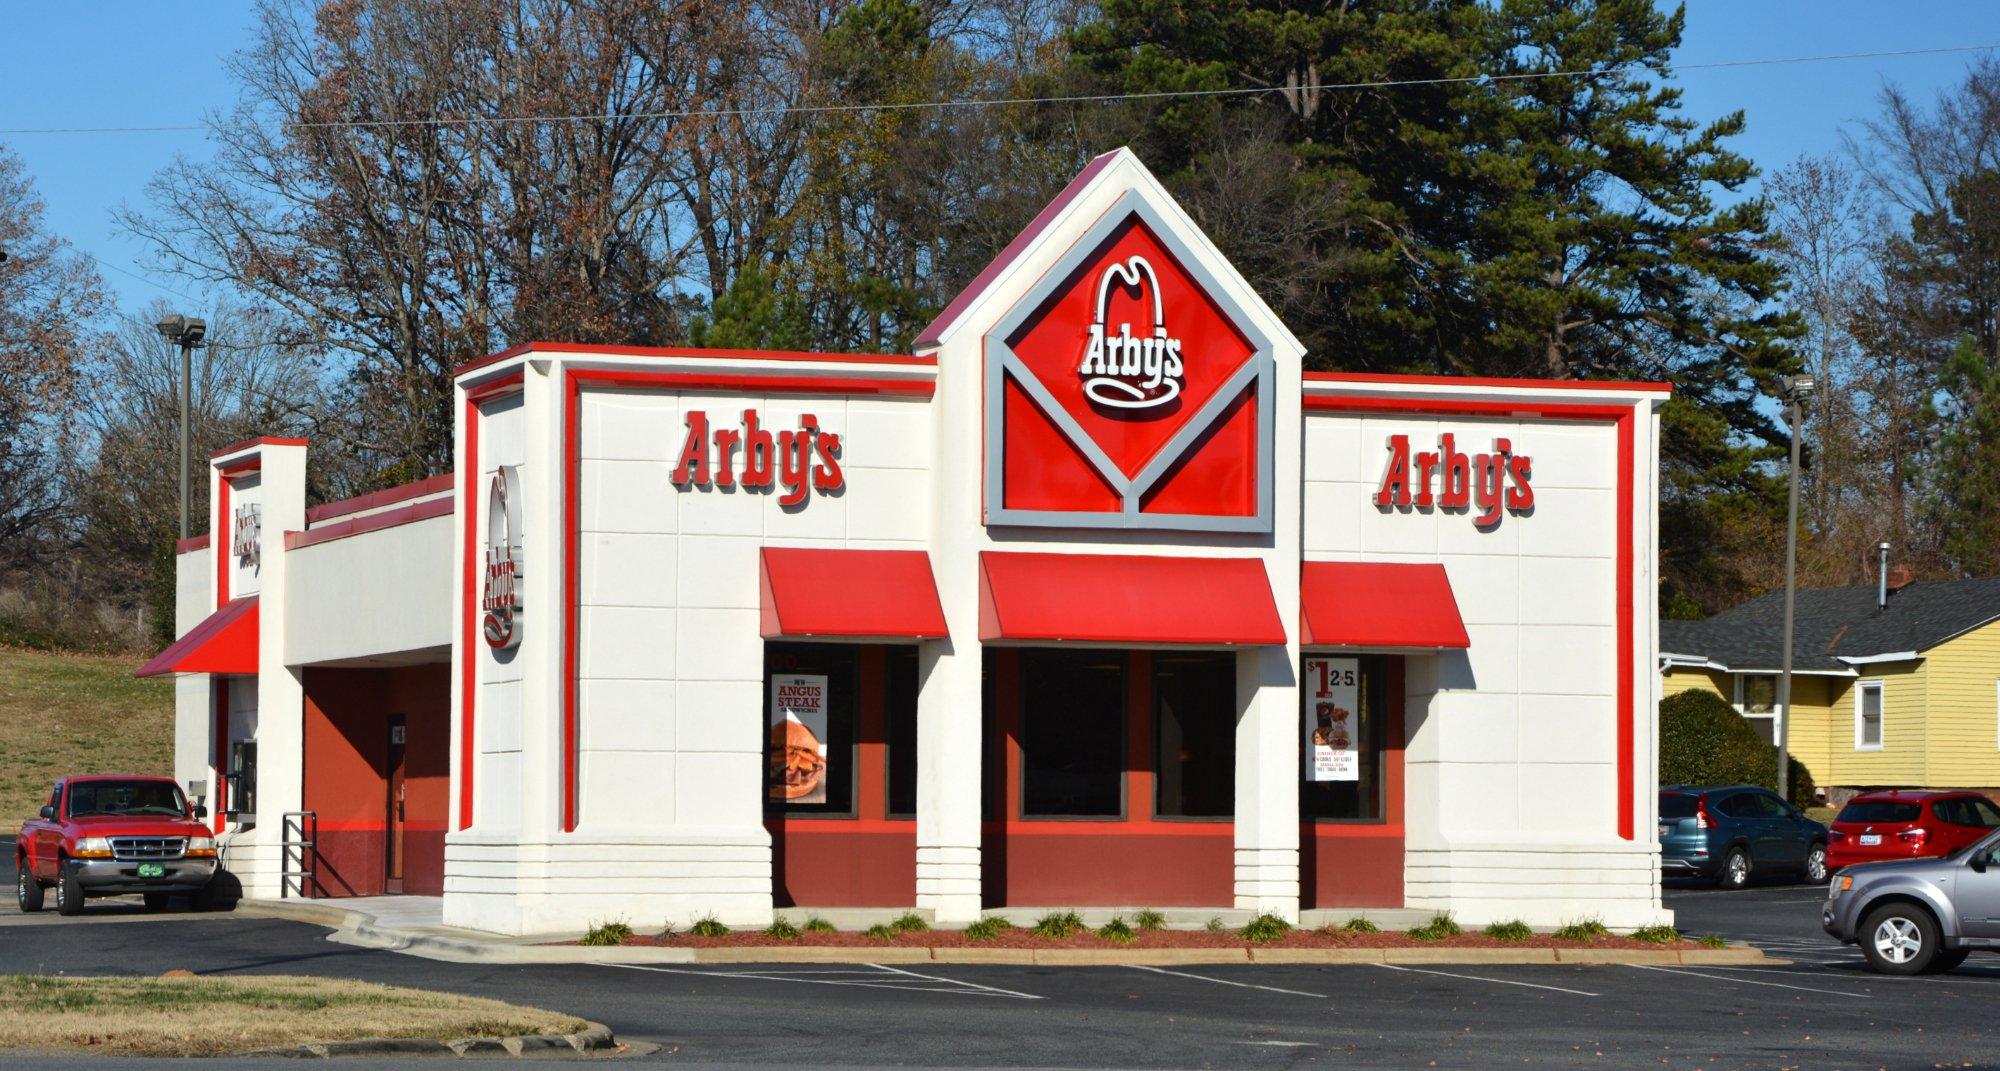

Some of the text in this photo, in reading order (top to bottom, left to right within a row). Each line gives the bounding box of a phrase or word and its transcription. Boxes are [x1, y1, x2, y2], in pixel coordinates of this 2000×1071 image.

[1079, 323, 1184, 389] Arby's
[671, 409, 844, 505] Arby's
[1374, 433, 1535, 526] Arby's
[778, 686, 821, 697] ANGUS
[778, 697, 820, 708] STEAK
